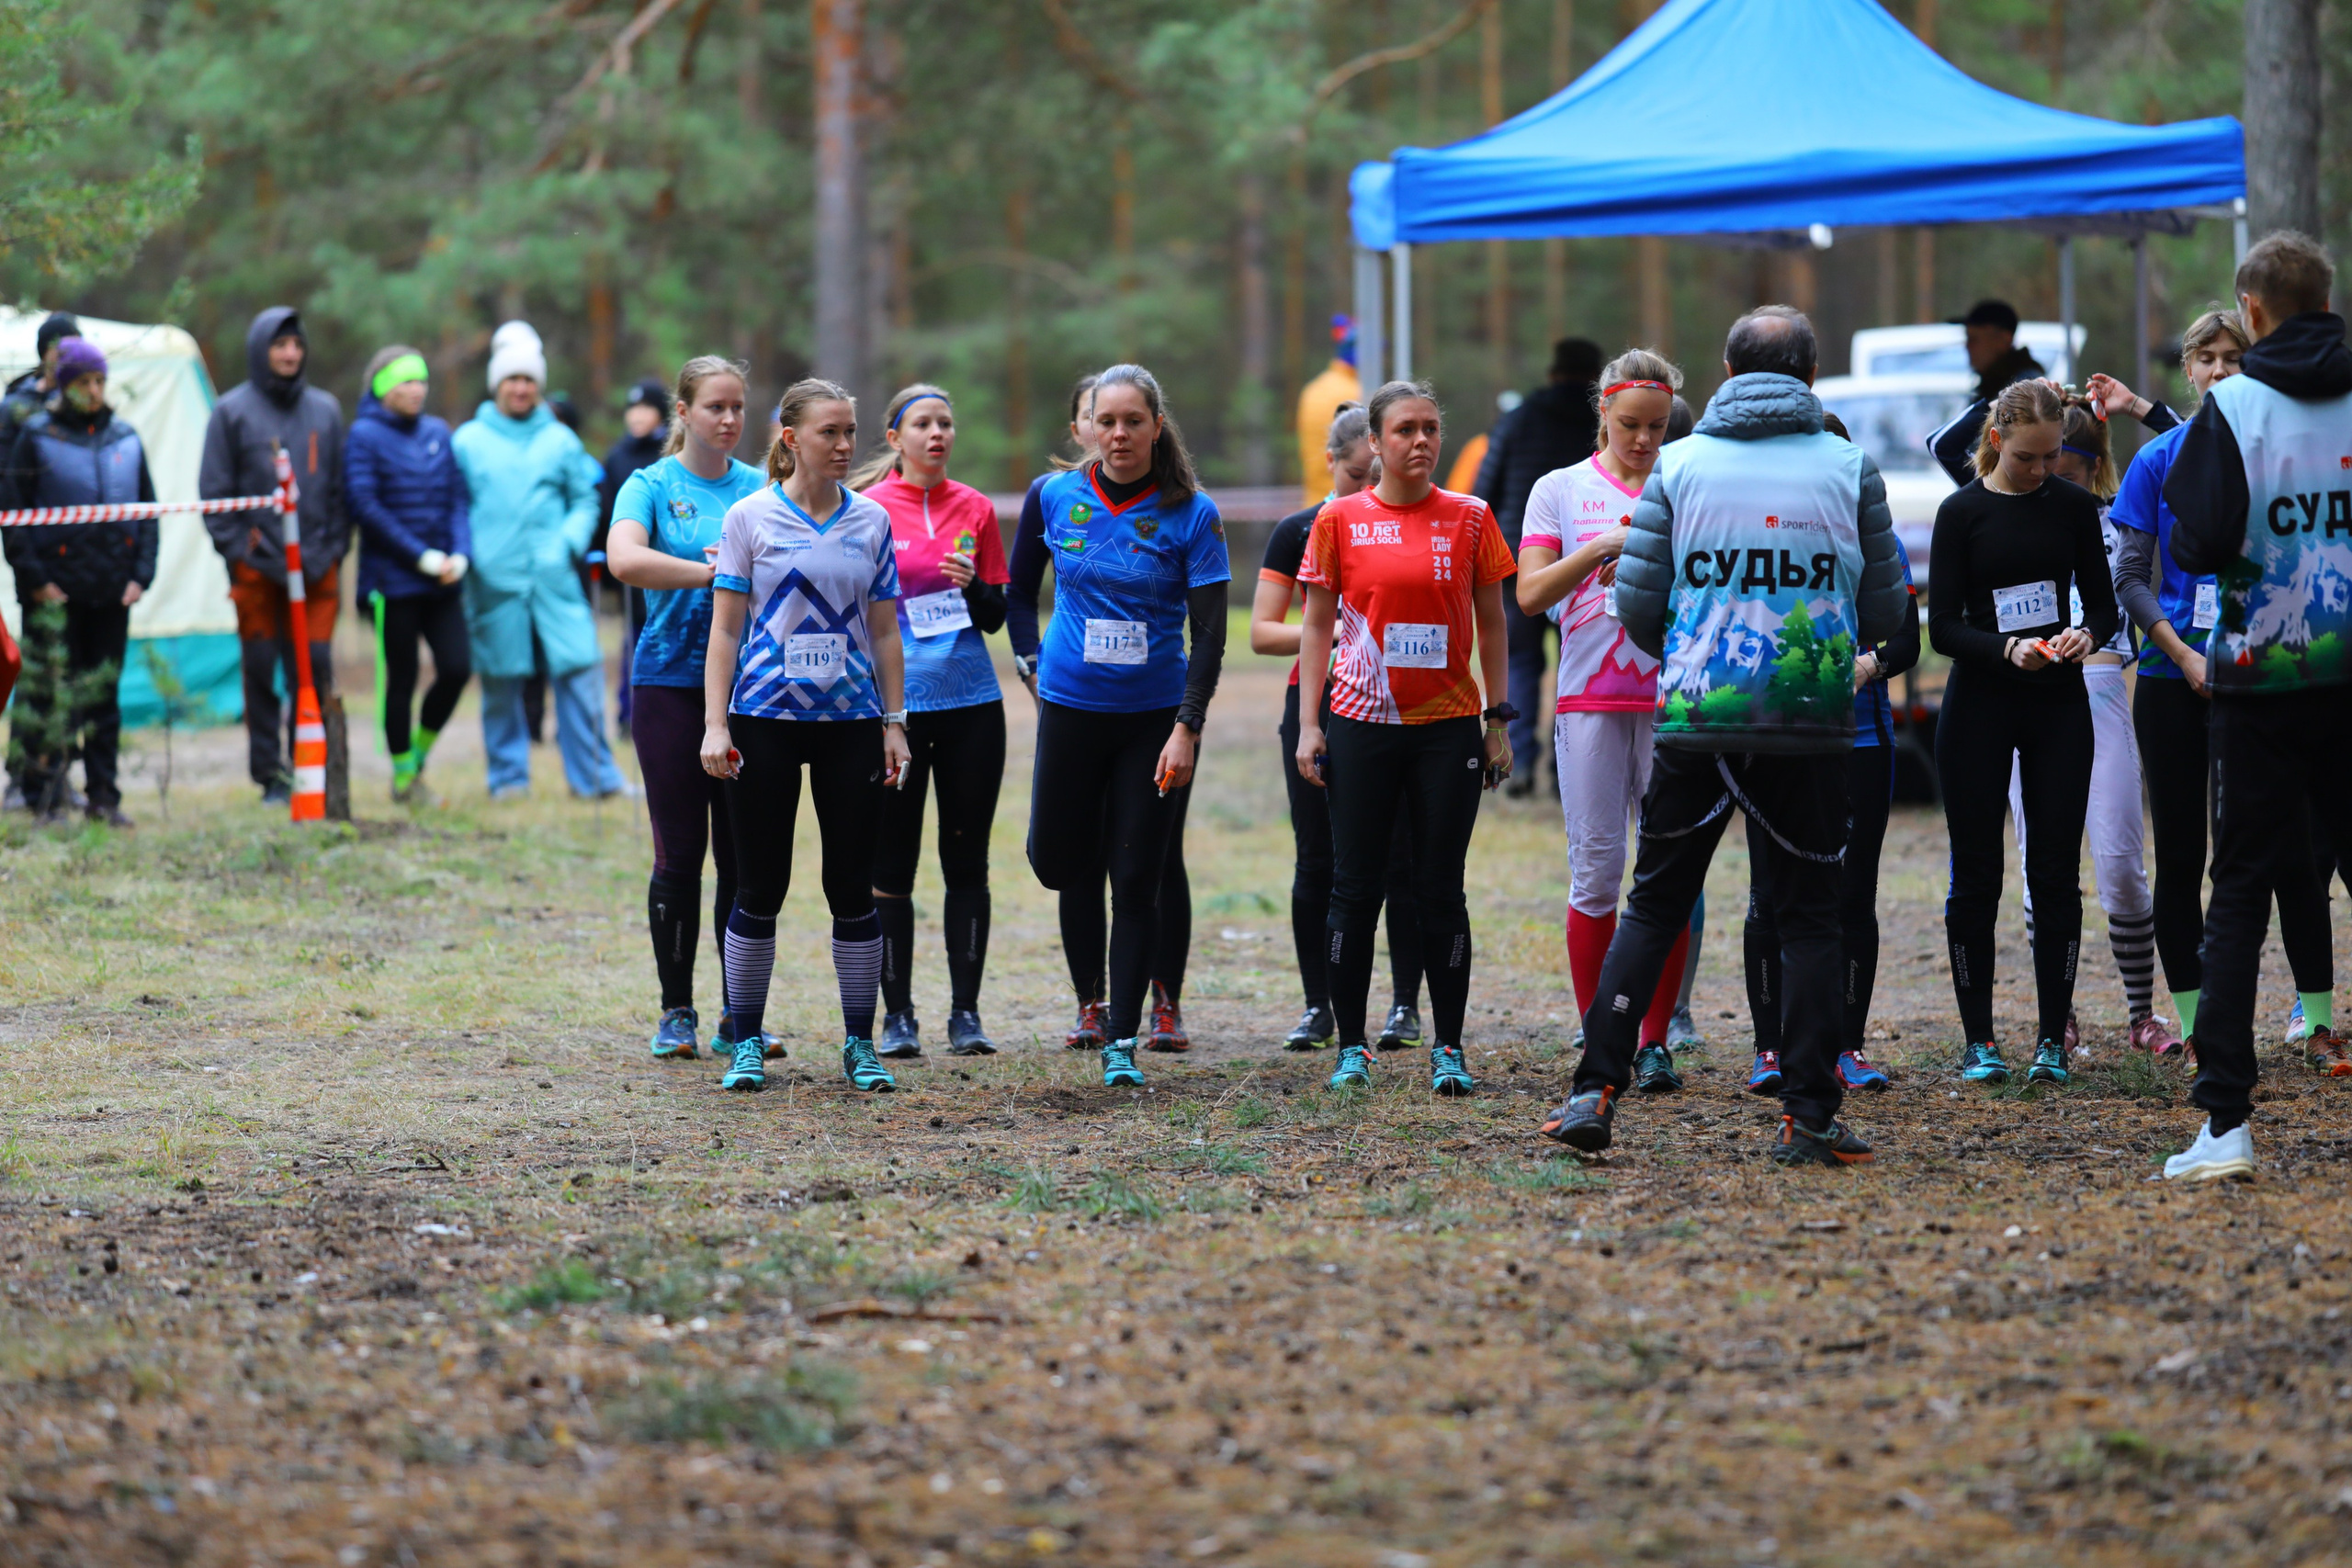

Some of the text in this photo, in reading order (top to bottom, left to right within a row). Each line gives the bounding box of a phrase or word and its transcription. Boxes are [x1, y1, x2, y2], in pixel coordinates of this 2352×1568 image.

[1583, 500, 1605, 513] KM
[1349, 523, 1400, 538] 10 лет
[1351, 536, 1402, 547] SIRIUS SOCHI
[1431, 543, 1452, 552] LADY
[1433, 556, 1452, 568] 20
[1434, 569, 1452, 581] 24
[1685, 548, 1836, 594] СУДЬЯ
[926, 606, 951, 621] 126
[2016, 598, 2041, 615] 112
[1104, 636, 1129, 650] 117
[1405, 641, 1430, 655] 116
[805, 652, 830, 666] 119
